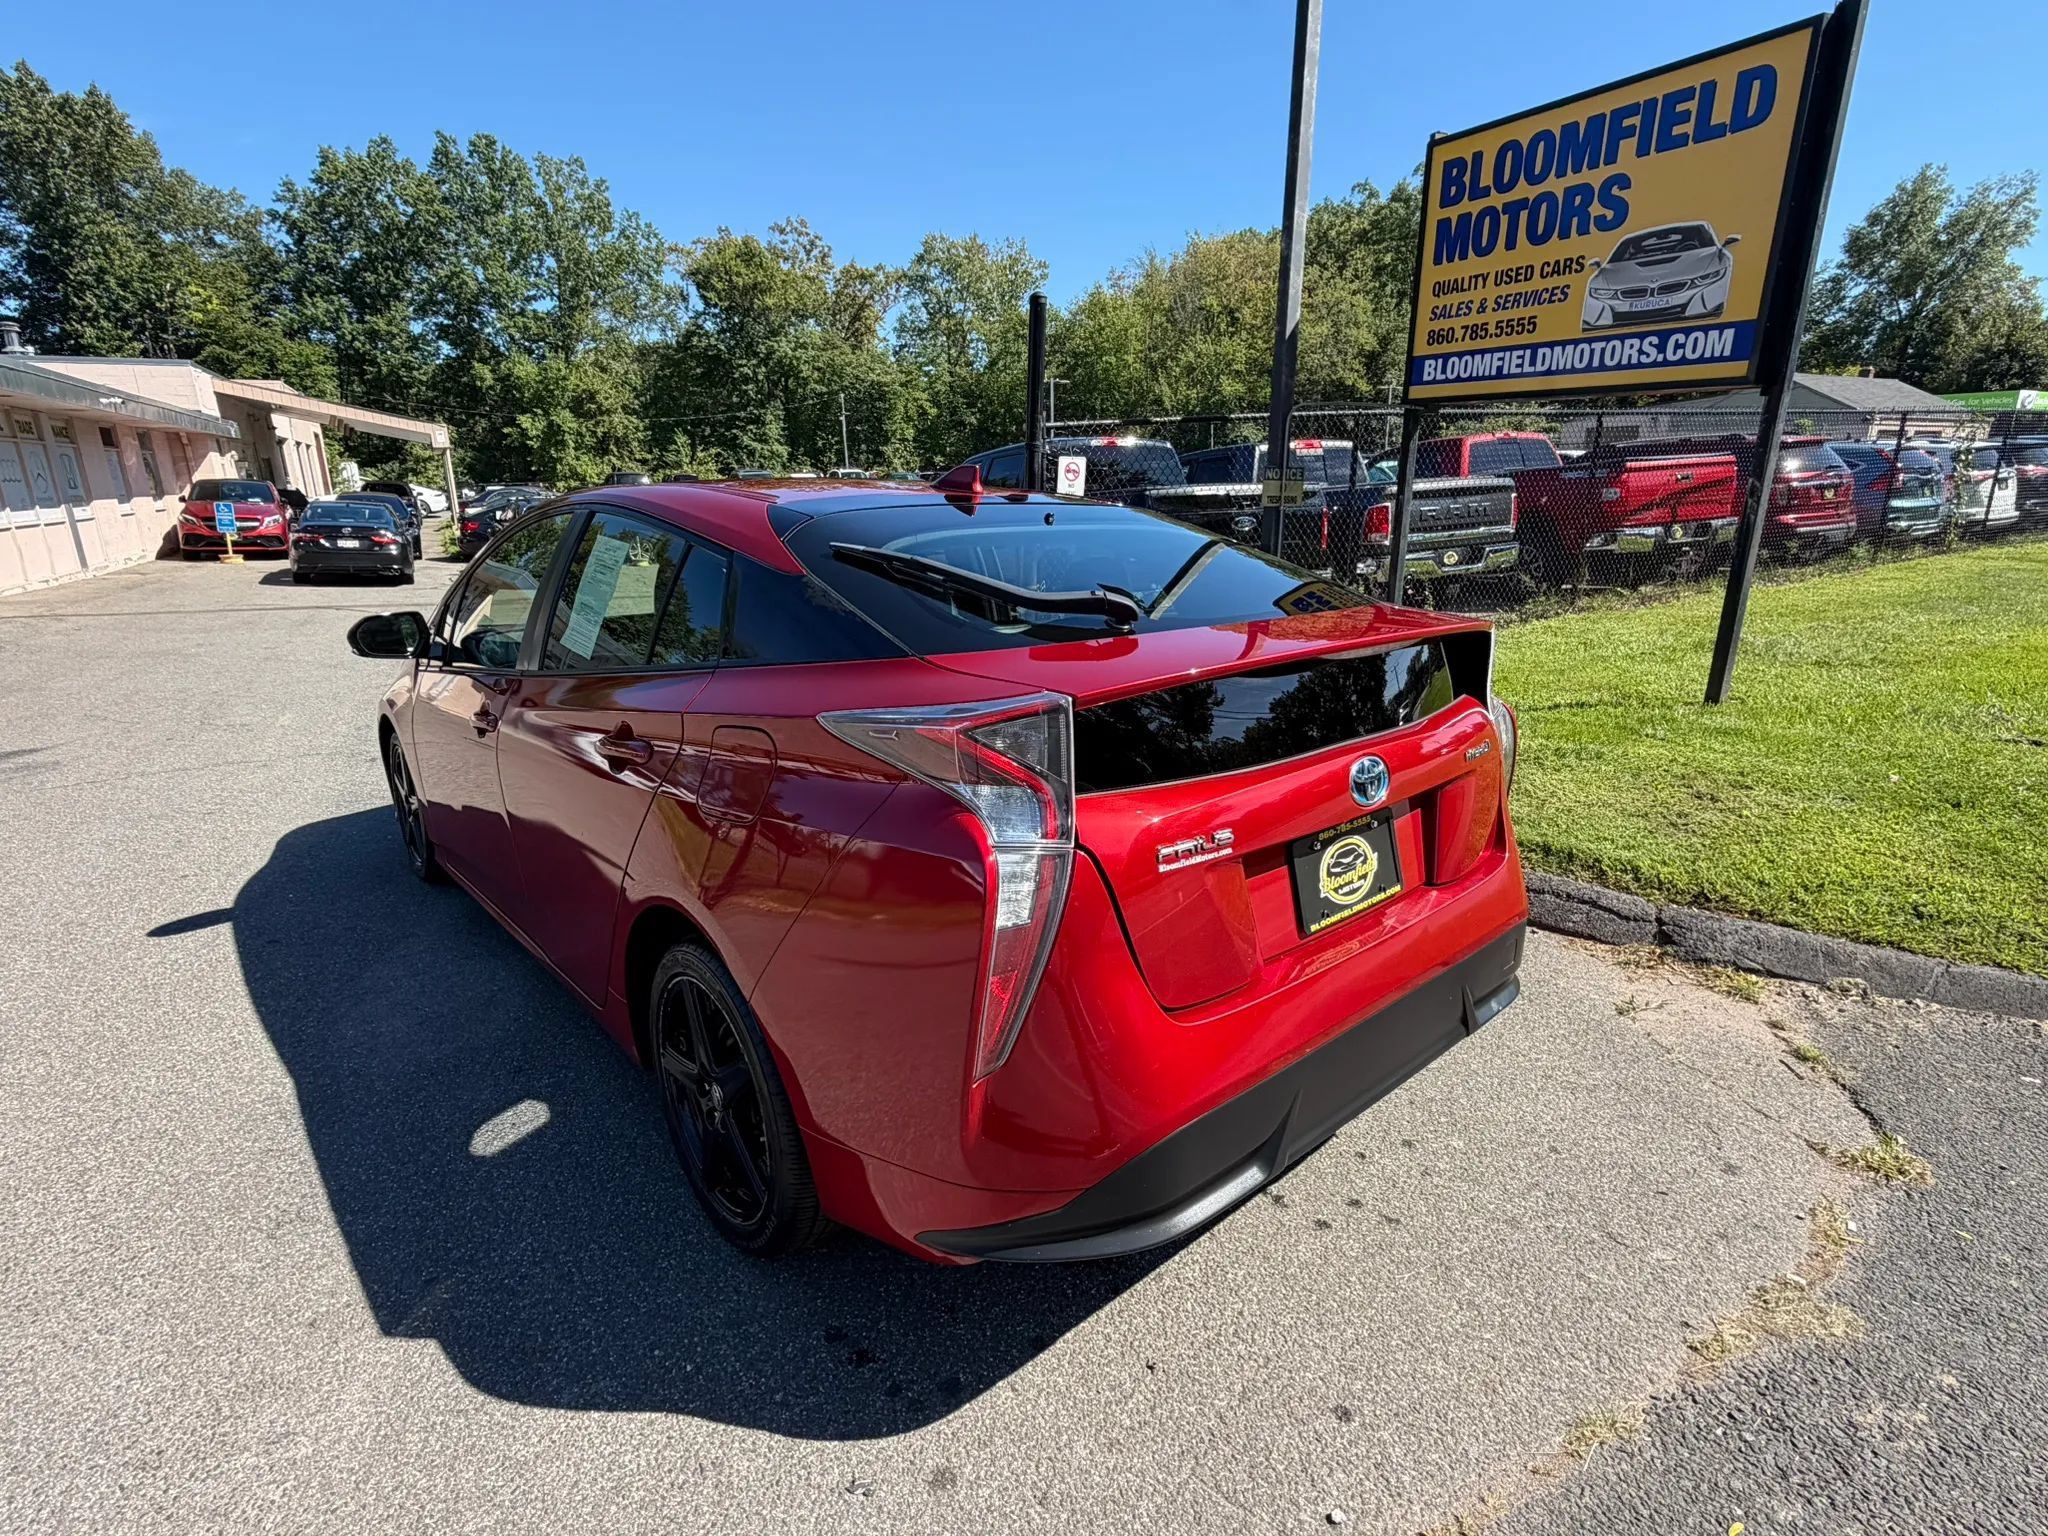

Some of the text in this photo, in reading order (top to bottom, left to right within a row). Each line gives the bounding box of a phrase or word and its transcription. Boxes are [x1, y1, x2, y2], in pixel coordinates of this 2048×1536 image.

[1439, 64, 1778, 209] BLOOMFIELD
[1433, 172, 1632, 266] MOTORS
[1432, 255, 1586, 298] QUALITY USED CARS
[1429, 284, 1571, 322] SALES & SERVICES
[1426, 315, 1538, 346] 860.785.5555
[1422, 328, 1735, 382] BLOOMFIELDMOTORS.COM
[1265, 467, 1303, 480] NOICE
[1156, 828, 1235, 864] PRIUS
[1318, 815, 1372, 841] 860-785-5555
[1322, 859, 1377, 892] Bloomfield
[1310, 884, 1402, 932] BLOOMFIELDMOTORS.COM
